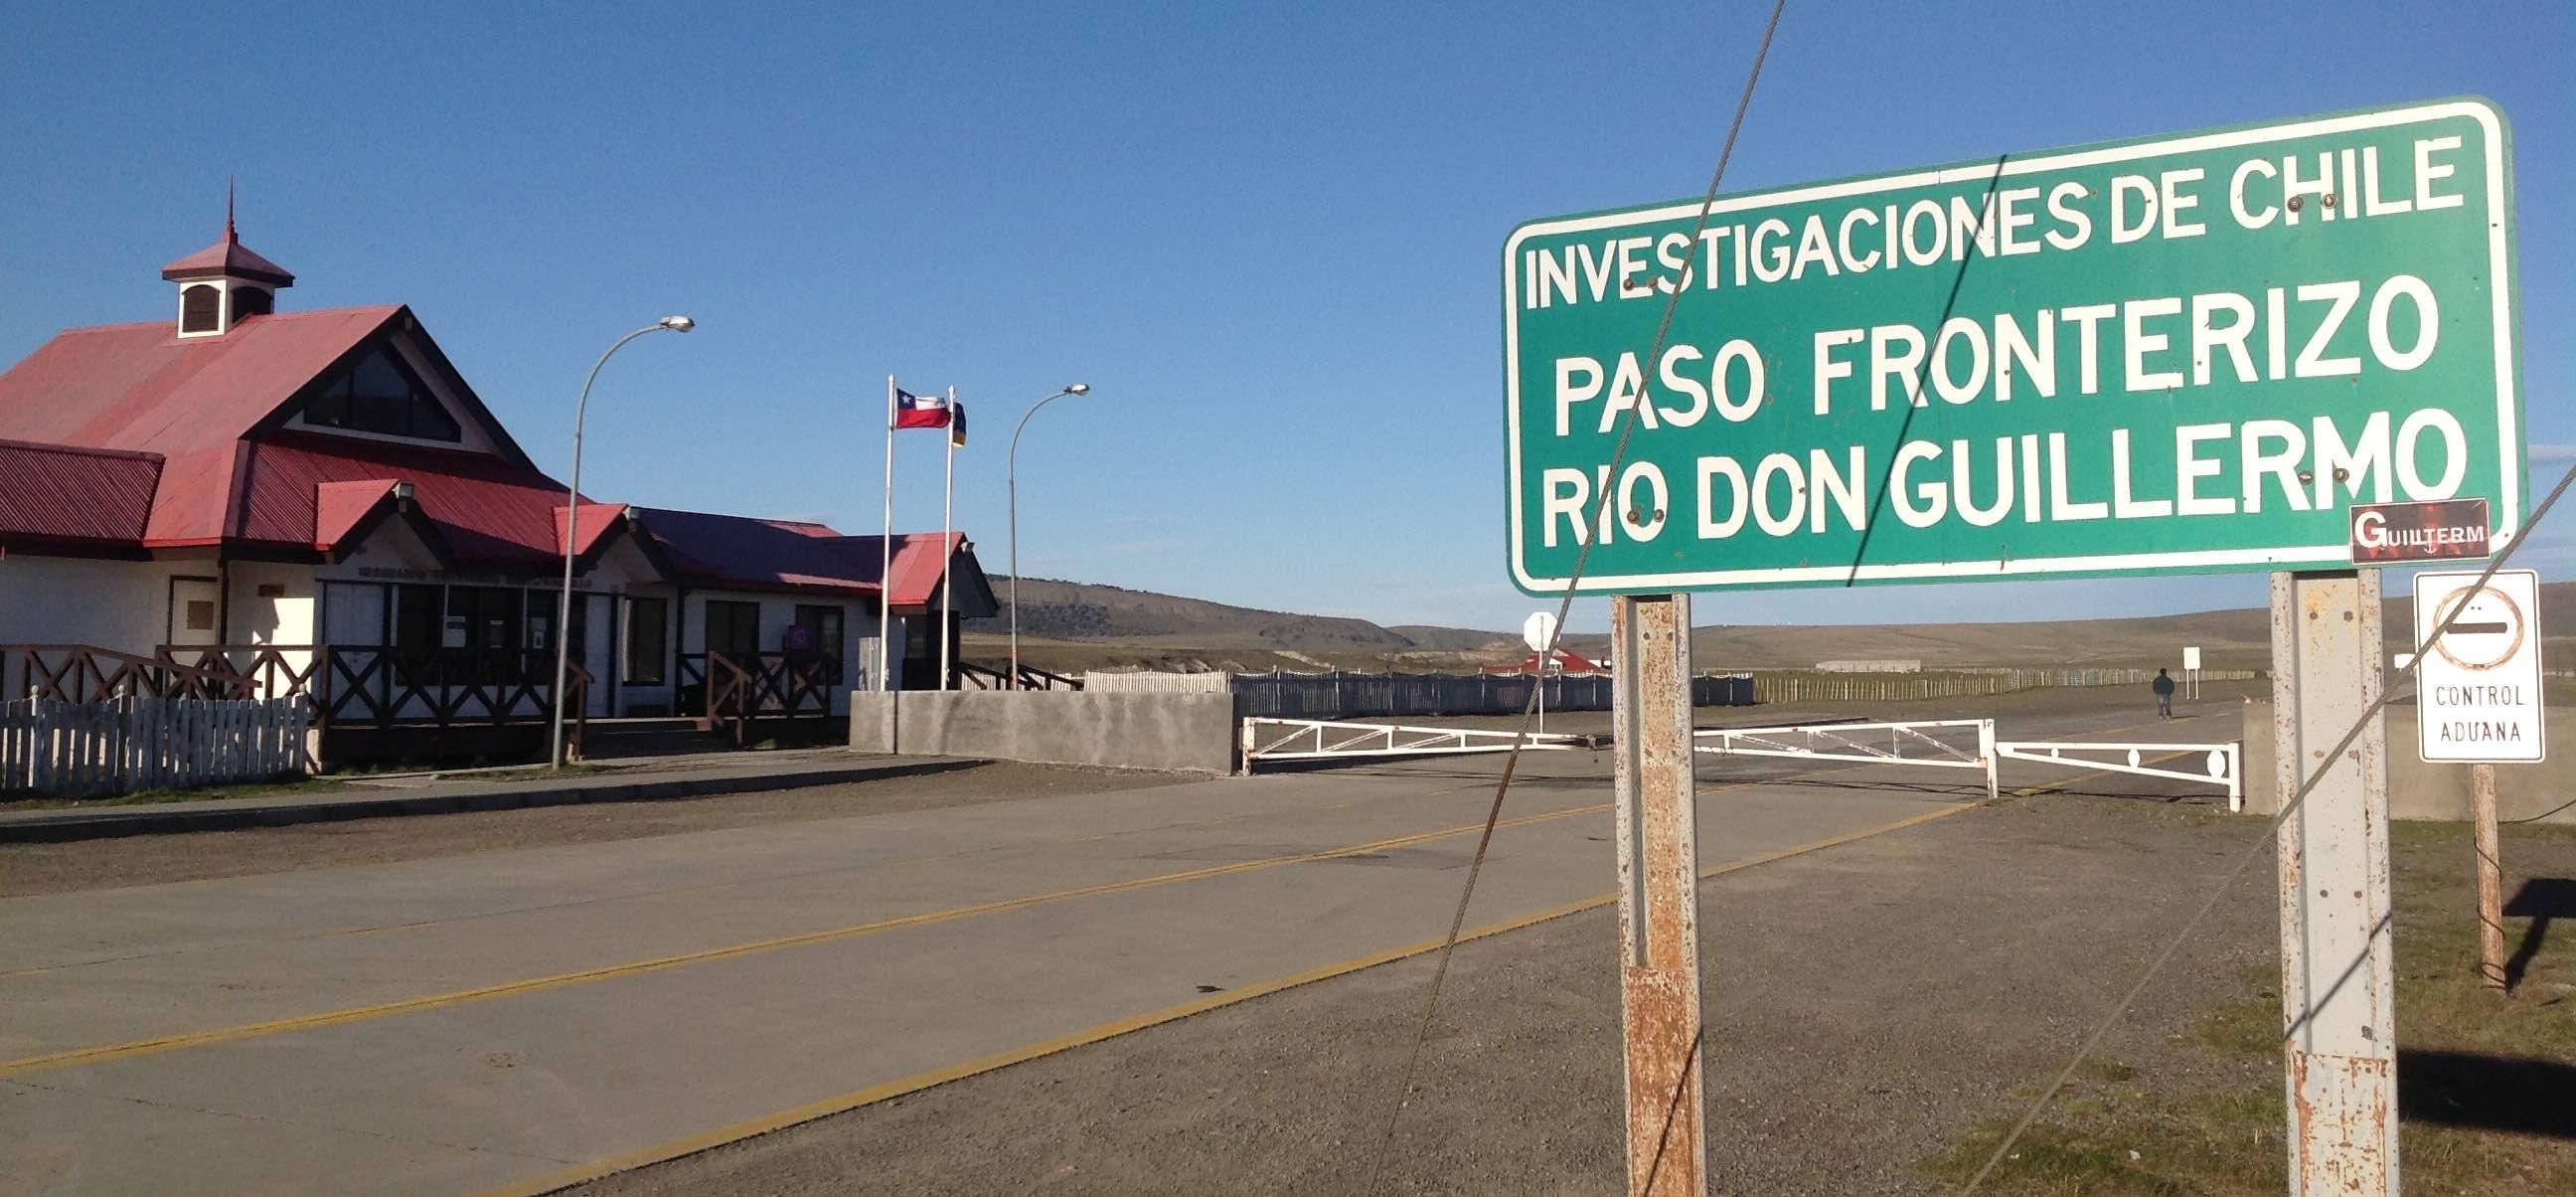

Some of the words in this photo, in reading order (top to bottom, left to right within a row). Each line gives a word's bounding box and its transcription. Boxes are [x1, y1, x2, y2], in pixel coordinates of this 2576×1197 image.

[1527, 181, 2093, 308] INVESTIGACIONES
[2111, 168, 2205, 245] DE
[2229, 135, 2464, 230] CHILE
[1554, 339, 1765, 437] PASO
[1814, 274, 2440, 416] FRONTERIZO
[1542, 460, 1669, 549] RIO
[1696, 445, 1867, 541] DON
[1889, 408, 2467, 529] GUILLERMO
[2436, 685, 2524, 707] CONTROL
[2441, 721, 2522, 743] ADUANA
